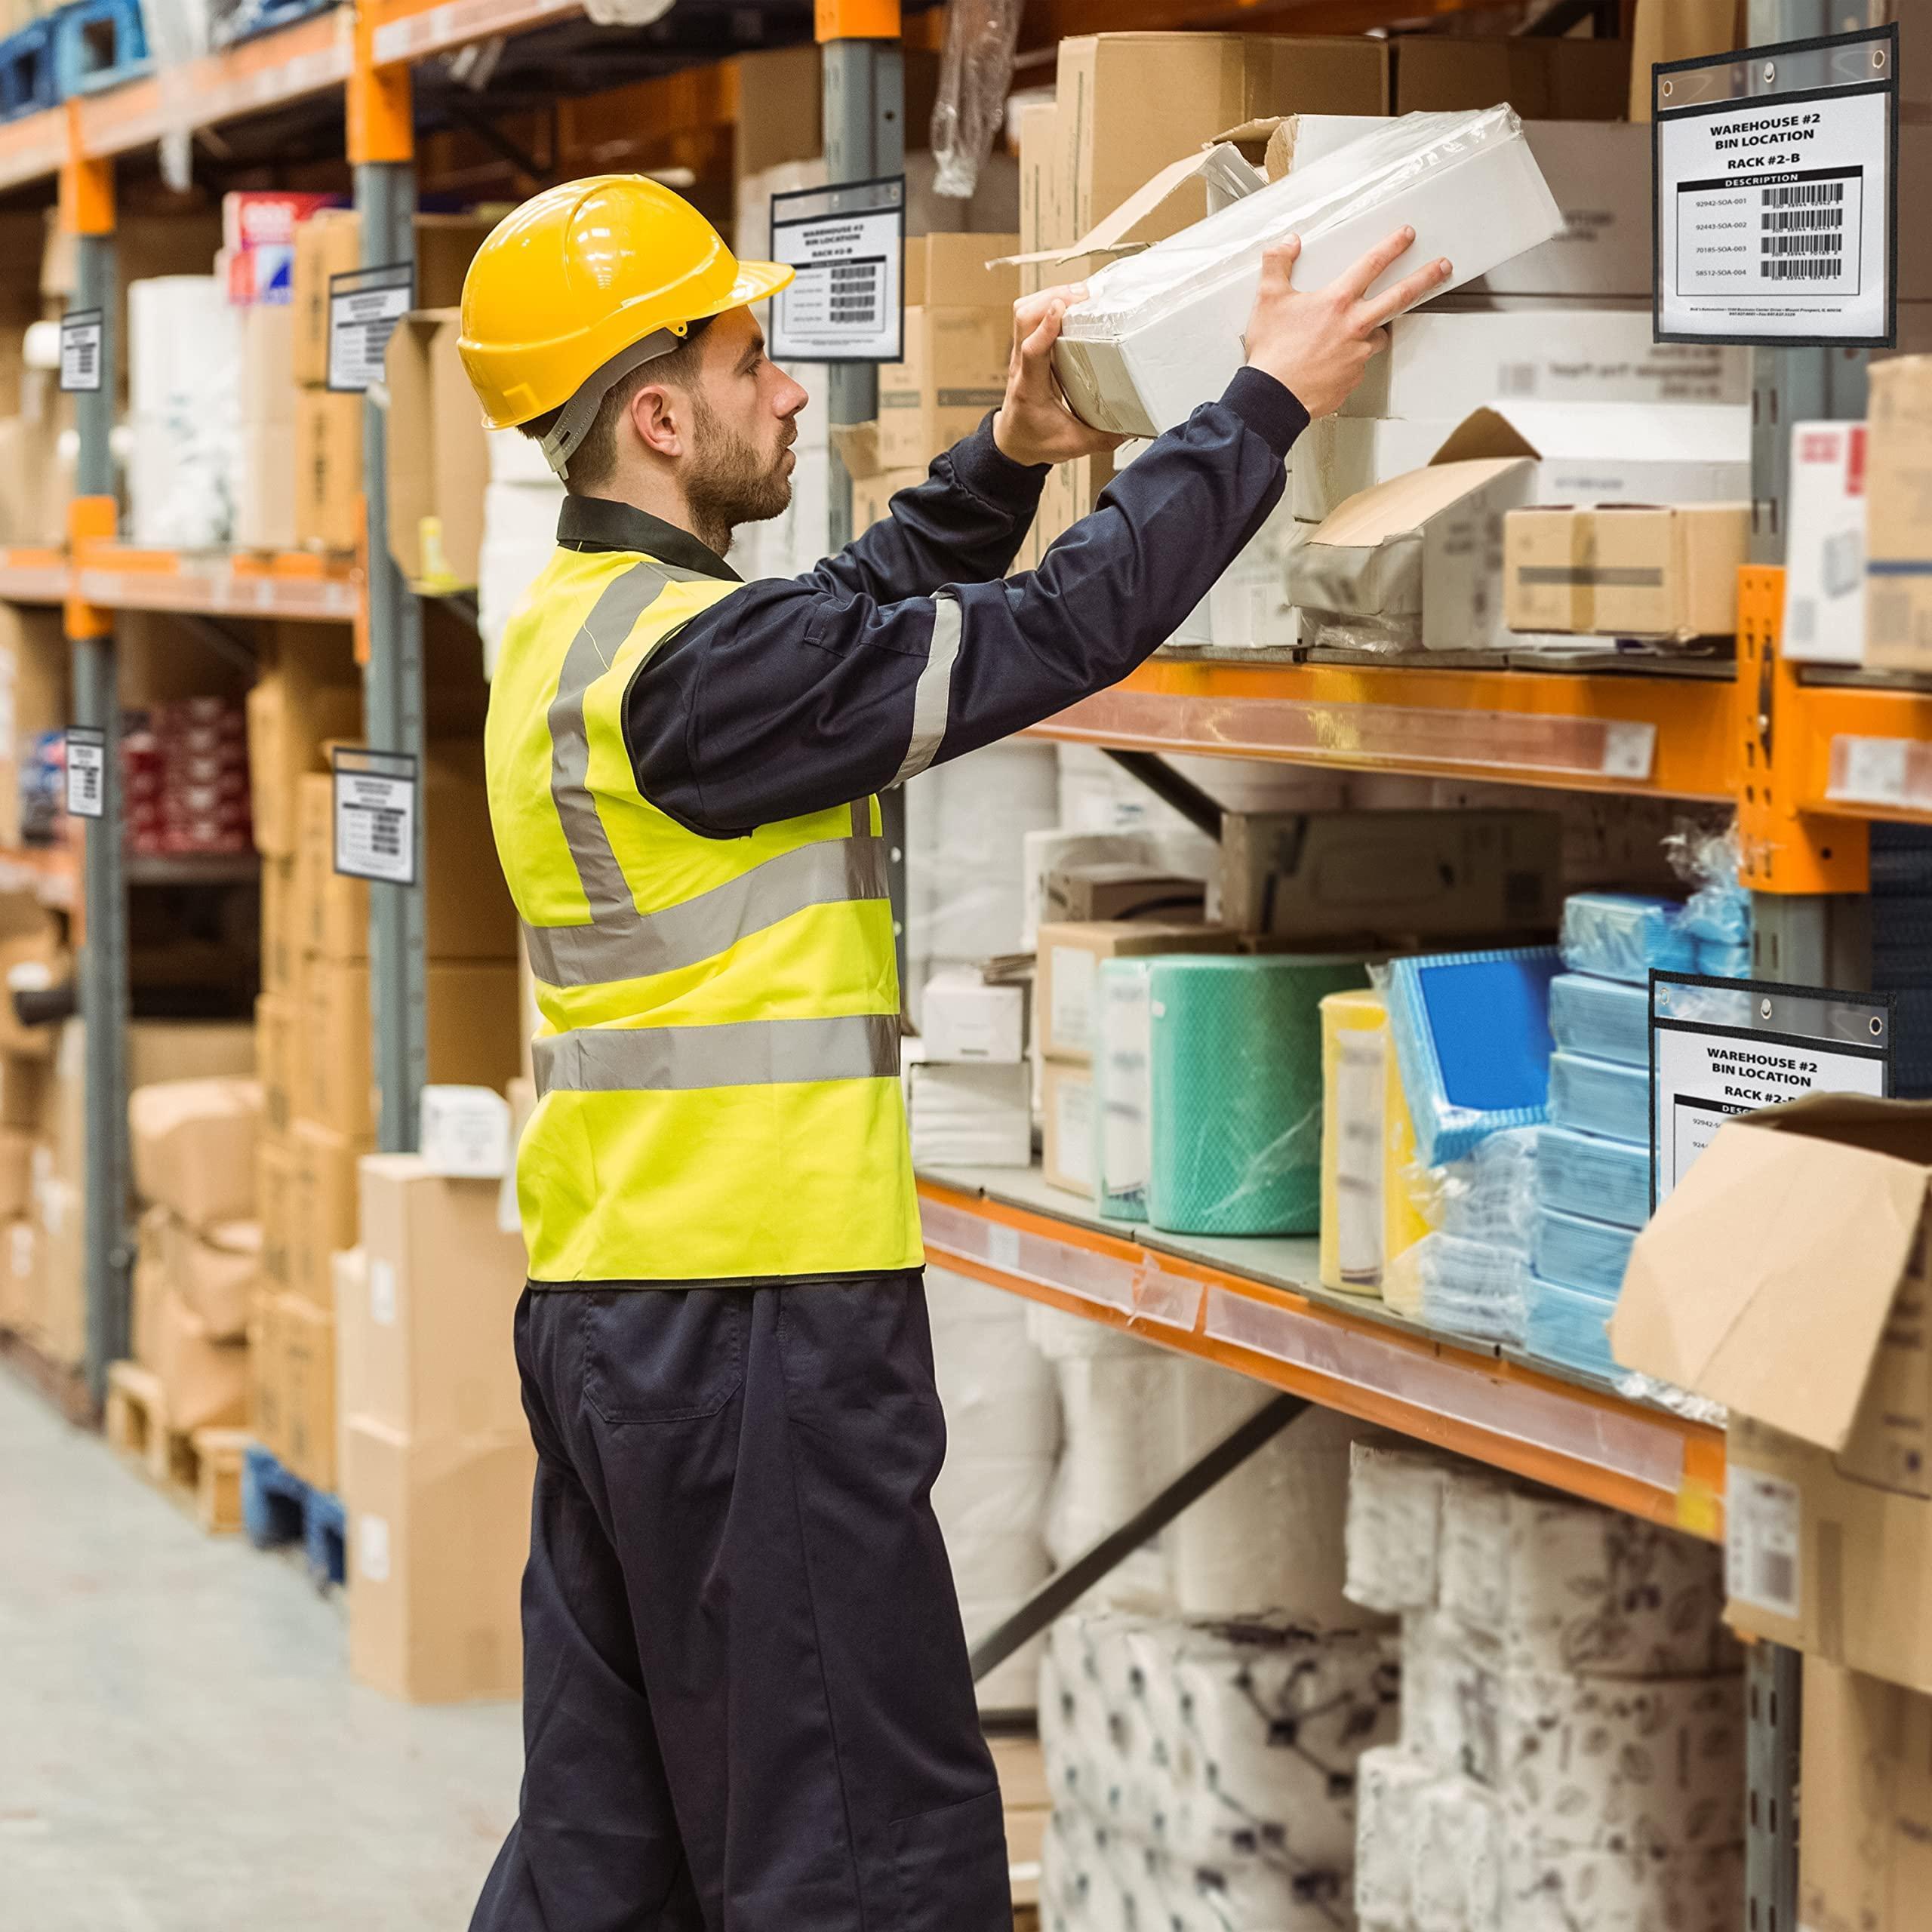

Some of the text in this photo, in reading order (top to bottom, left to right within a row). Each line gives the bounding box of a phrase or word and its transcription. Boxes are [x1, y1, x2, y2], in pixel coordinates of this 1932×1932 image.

[1710, 113, 1821, 137] WAREHOUSE #2
[1715, 129, 1815, 150] BIN LOCATION
[1727, 152, 1801, 170] RACK #2-B
[1725, 174, 1798, 187] DESCRIPTION
[1696, 198, 1747, 208] 92942-SOA-001
[1696, 222, 1747, 231] 92443-SOA-002
[1696, 245, 1747, 254] 70185-SOA-003
[1707, 1048, 1818, 1073] WAREHOUSE #2
[1712, 1063, 1812, 1087] BIN LOCATION
[1724, 1086, 1762, 1101] RACK
